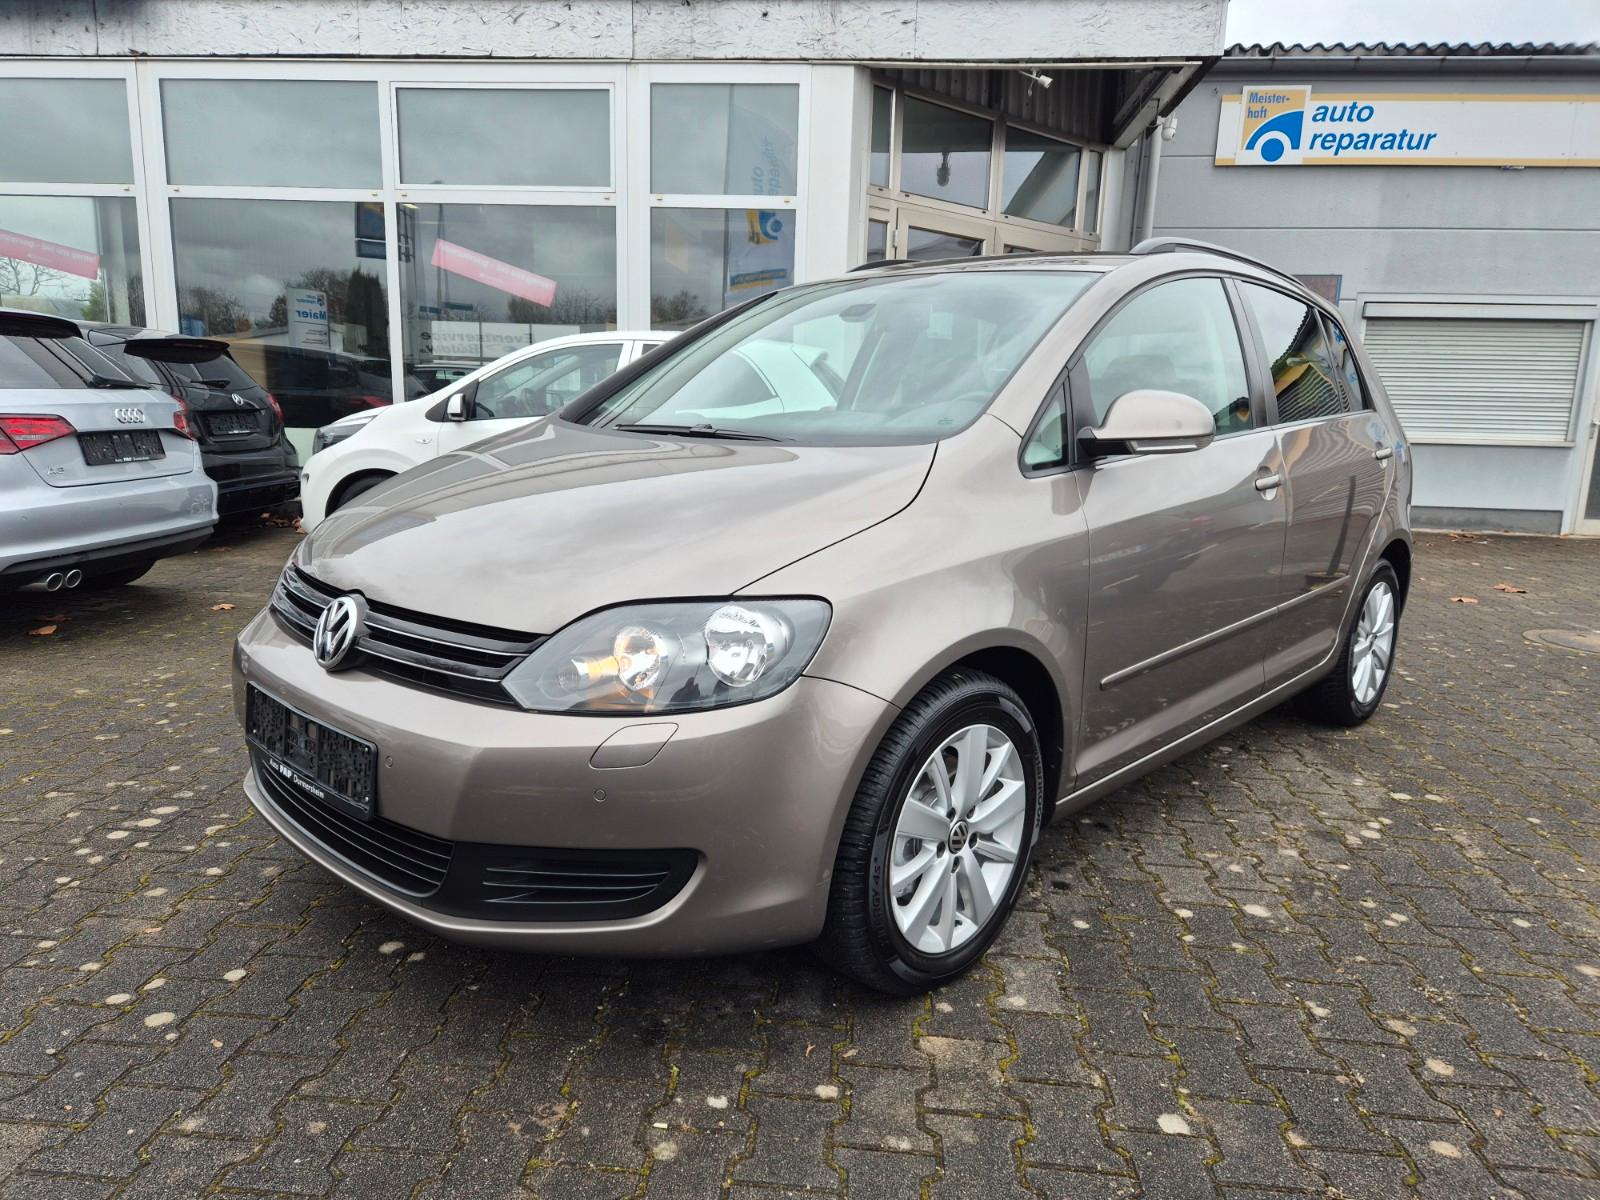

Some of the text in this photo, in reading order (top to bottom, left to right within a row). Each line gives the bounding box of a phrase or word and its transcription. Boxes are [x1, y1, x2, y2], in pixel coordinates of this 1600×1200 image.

[1249, 92, 1291, 105] Meister-
[1247, 105, 1268, 119] haft
[1311, 101, 1375, 123] auto
[1309, 129, 1437, 155] reparatur
